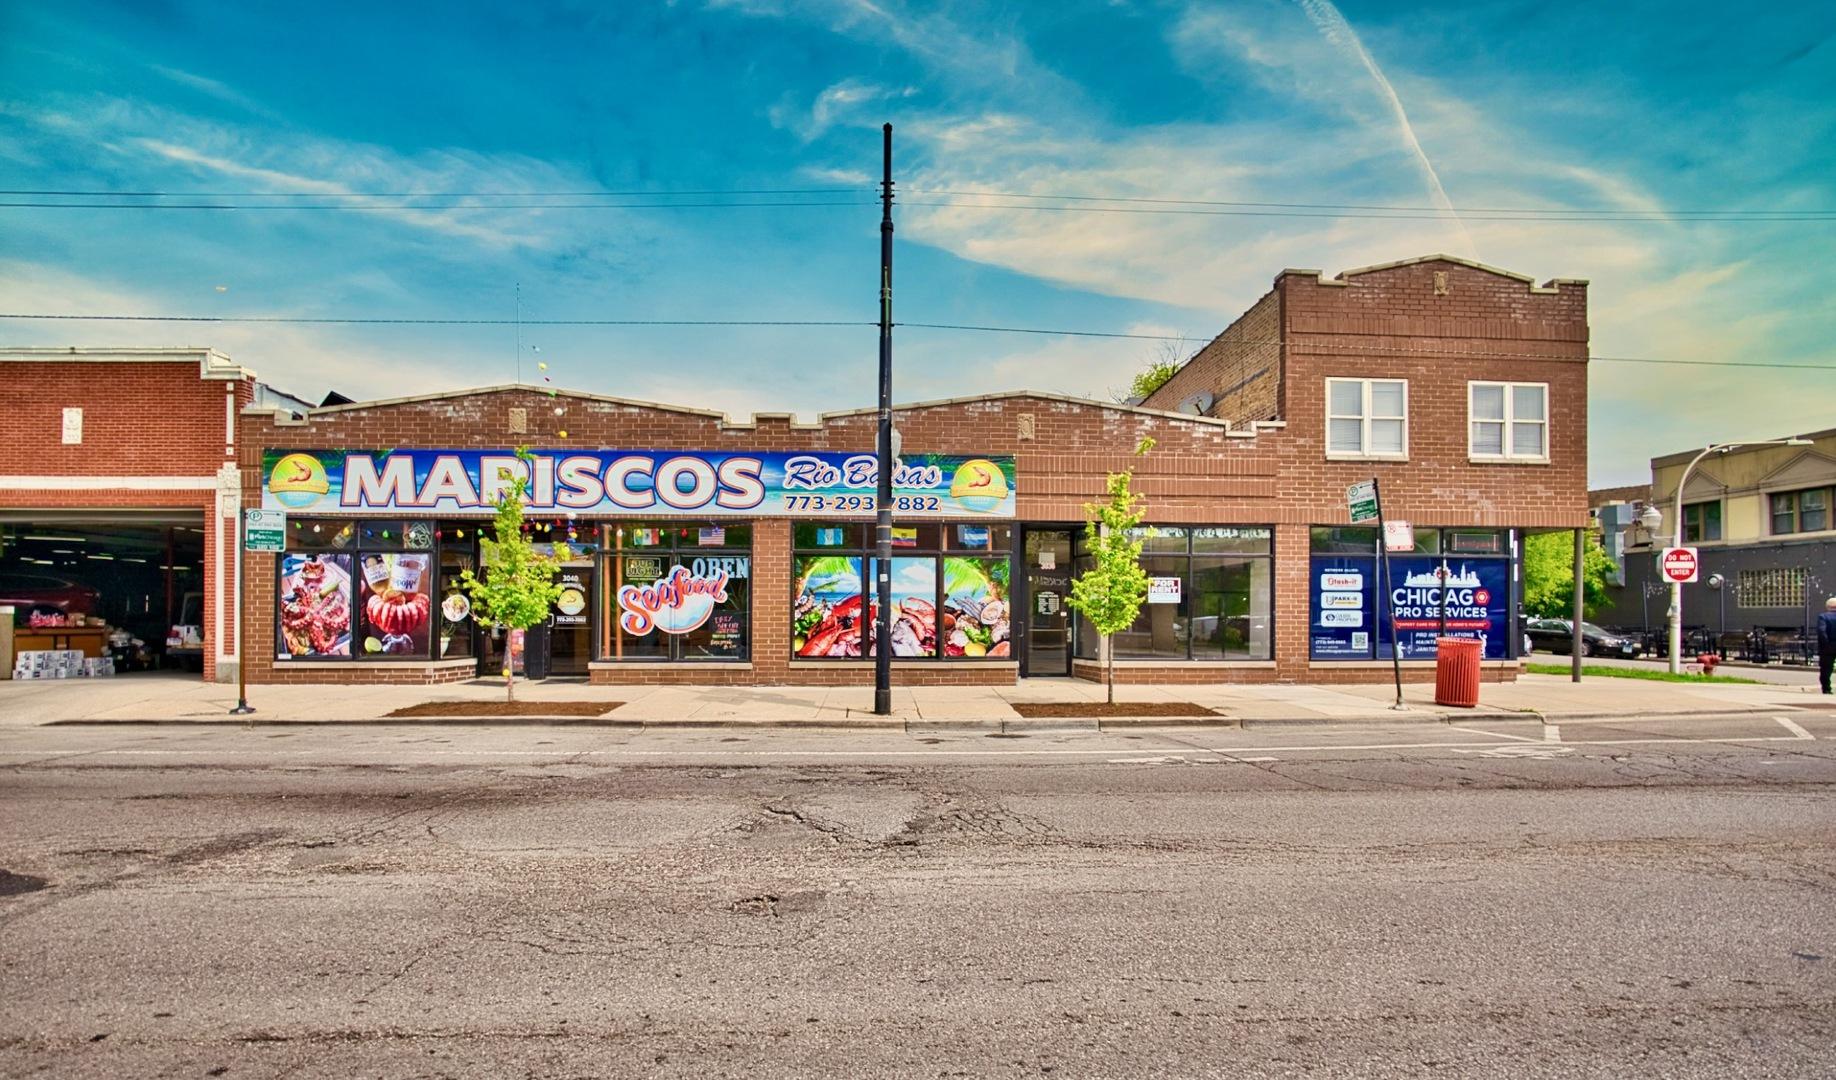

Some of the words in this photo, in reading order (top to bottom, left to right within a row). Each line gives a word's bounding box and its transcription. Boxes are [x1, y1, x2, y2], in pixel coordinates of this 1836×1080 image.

[340, 455, 766, 509] MARISCOS
[785, 457, 838, 487] Rio
[845, 457, 939, 487] Basas
[785, 495, 939, 512] 773-293882
[562, 574, 580, 582] 3040
[692, 556, 748, 578] OPEN
[618, 565, 728, 636] Seafood
[1395, 607, 1422, 618] PRO
[1425, 607, 1488, 618] SERVICES
